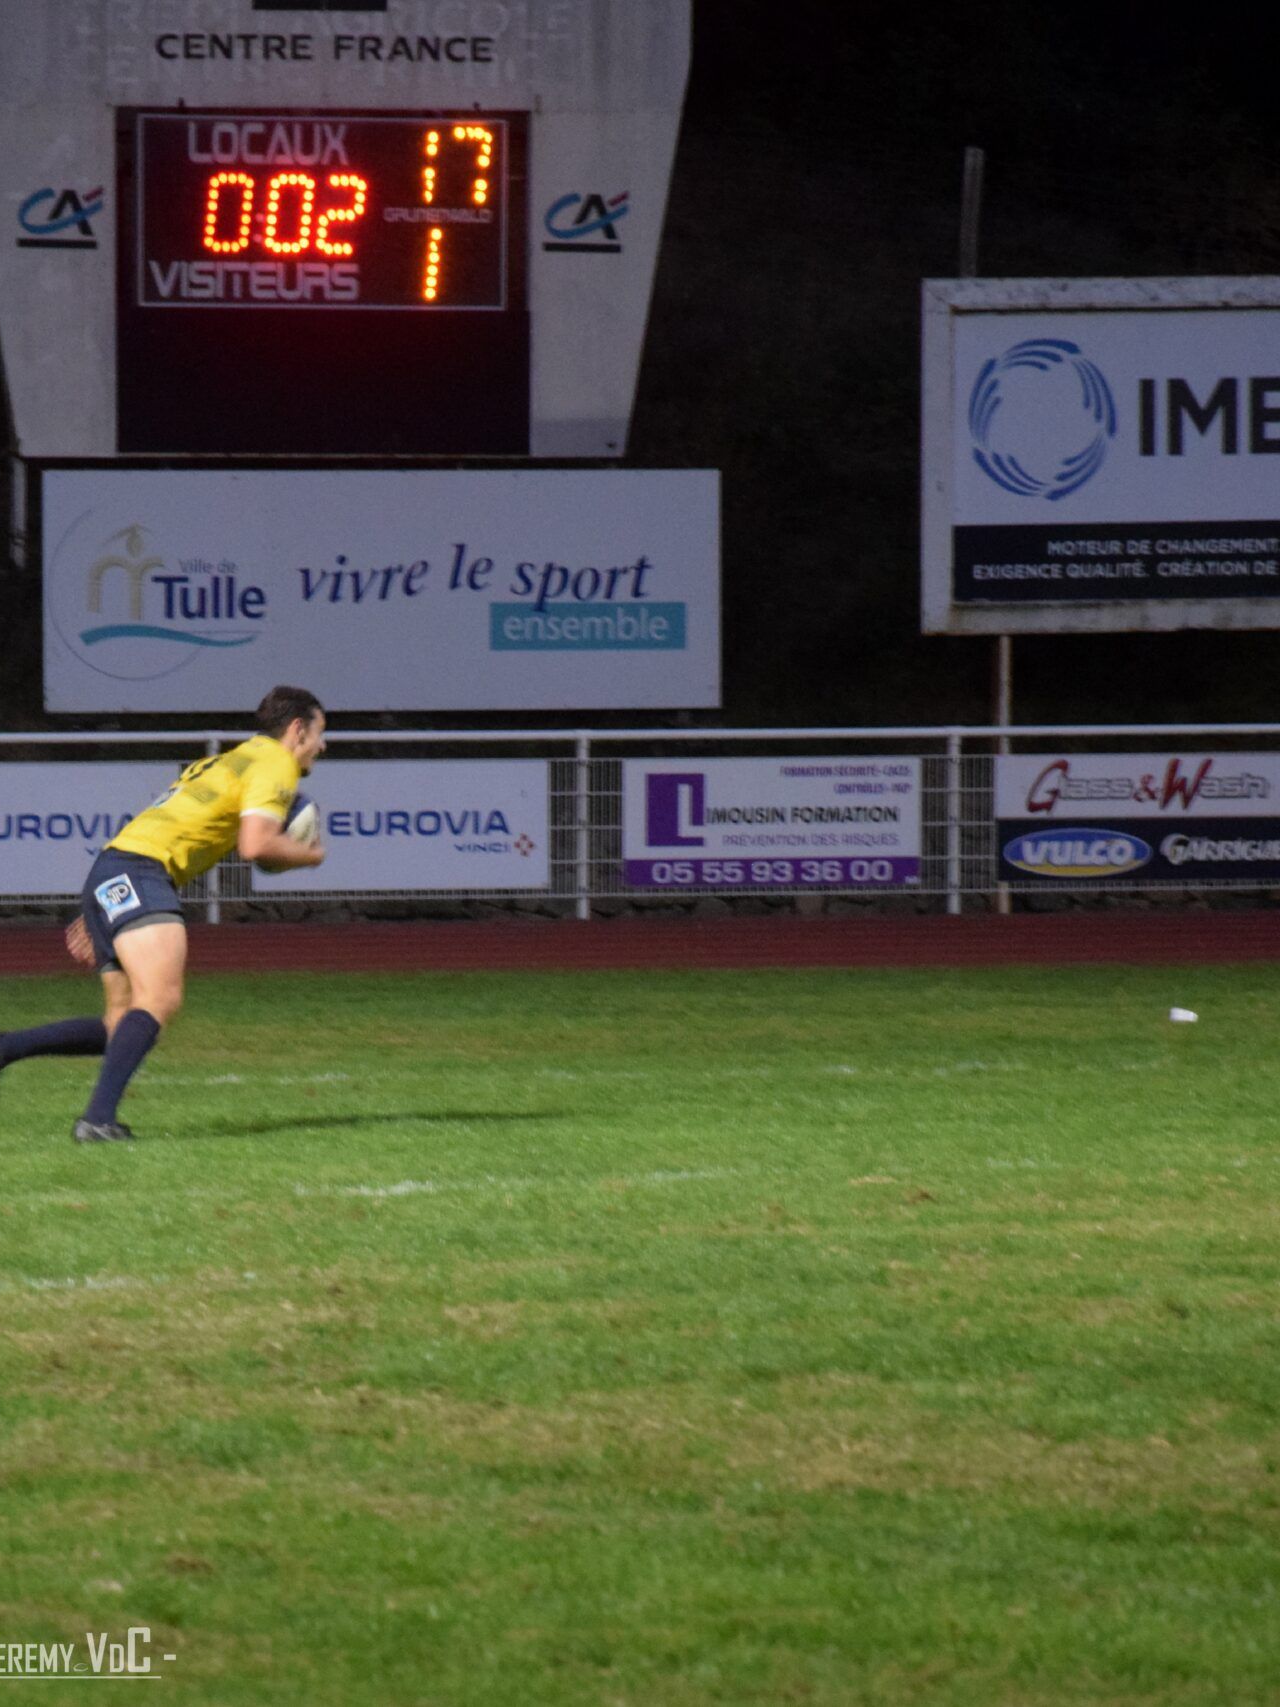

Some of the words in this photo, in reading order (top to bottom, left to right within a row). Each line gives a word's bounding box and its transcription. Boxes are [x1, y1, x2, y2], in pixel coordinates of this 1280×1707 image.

[155, 34, 313, 61] CENTRE
[334, 35, 494, 62] FRANCE
[187, 122, 349, 166] LOCAUX
[424, 125, 494, 204] 17
[149, 260, 361, 300] VISITEURS
[1047, 539, 1124, 556] MOTEUR
[1126, 538, 1153, 556] DE
[298, 554, 430, 604] vivre
[449, 541, 494, 591] le
[510, 555, 652, 614] sport
[972, 562, 1064, 581] EXIGENCE
[1156, 557, 1251, 578] CRÉATION
[1253, 560, 1280, 577] DE
[151, 576, 266, 619] Tulle
[503, 607, 670, 642] ensemble
[1159, 757, 1268, 810] Wash
[327, 809, 511, 836] EUROVIA
[791, 806, 898, 823] FORMATION
[1021, 838, 1136, 867] VULCO
[651, 861, 696, 884] 05
[701, 860, 746, 883] 55
[750, 860, 795, 883] 93
[800, 860, 844, 882] 36
[849, 859, 894, 882] 00
